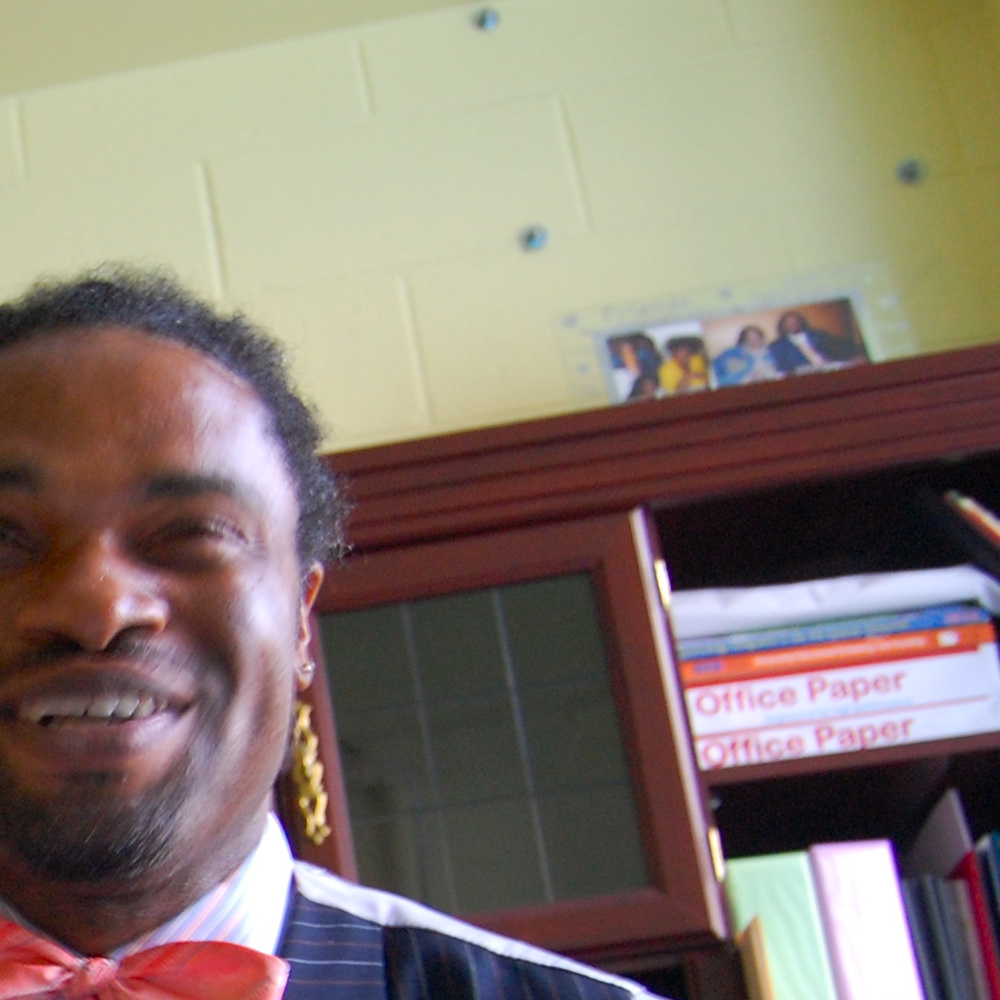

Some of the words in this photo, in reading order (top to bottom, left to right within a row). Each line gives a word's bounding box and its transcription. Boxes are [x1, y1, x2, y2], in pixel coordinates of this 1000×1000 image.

[696, 682, 799, 716] Office
[807, 671, 907, 703] Paper
[702, 736, 807, 768] Office
[815, 717, 916, 751] Paper
